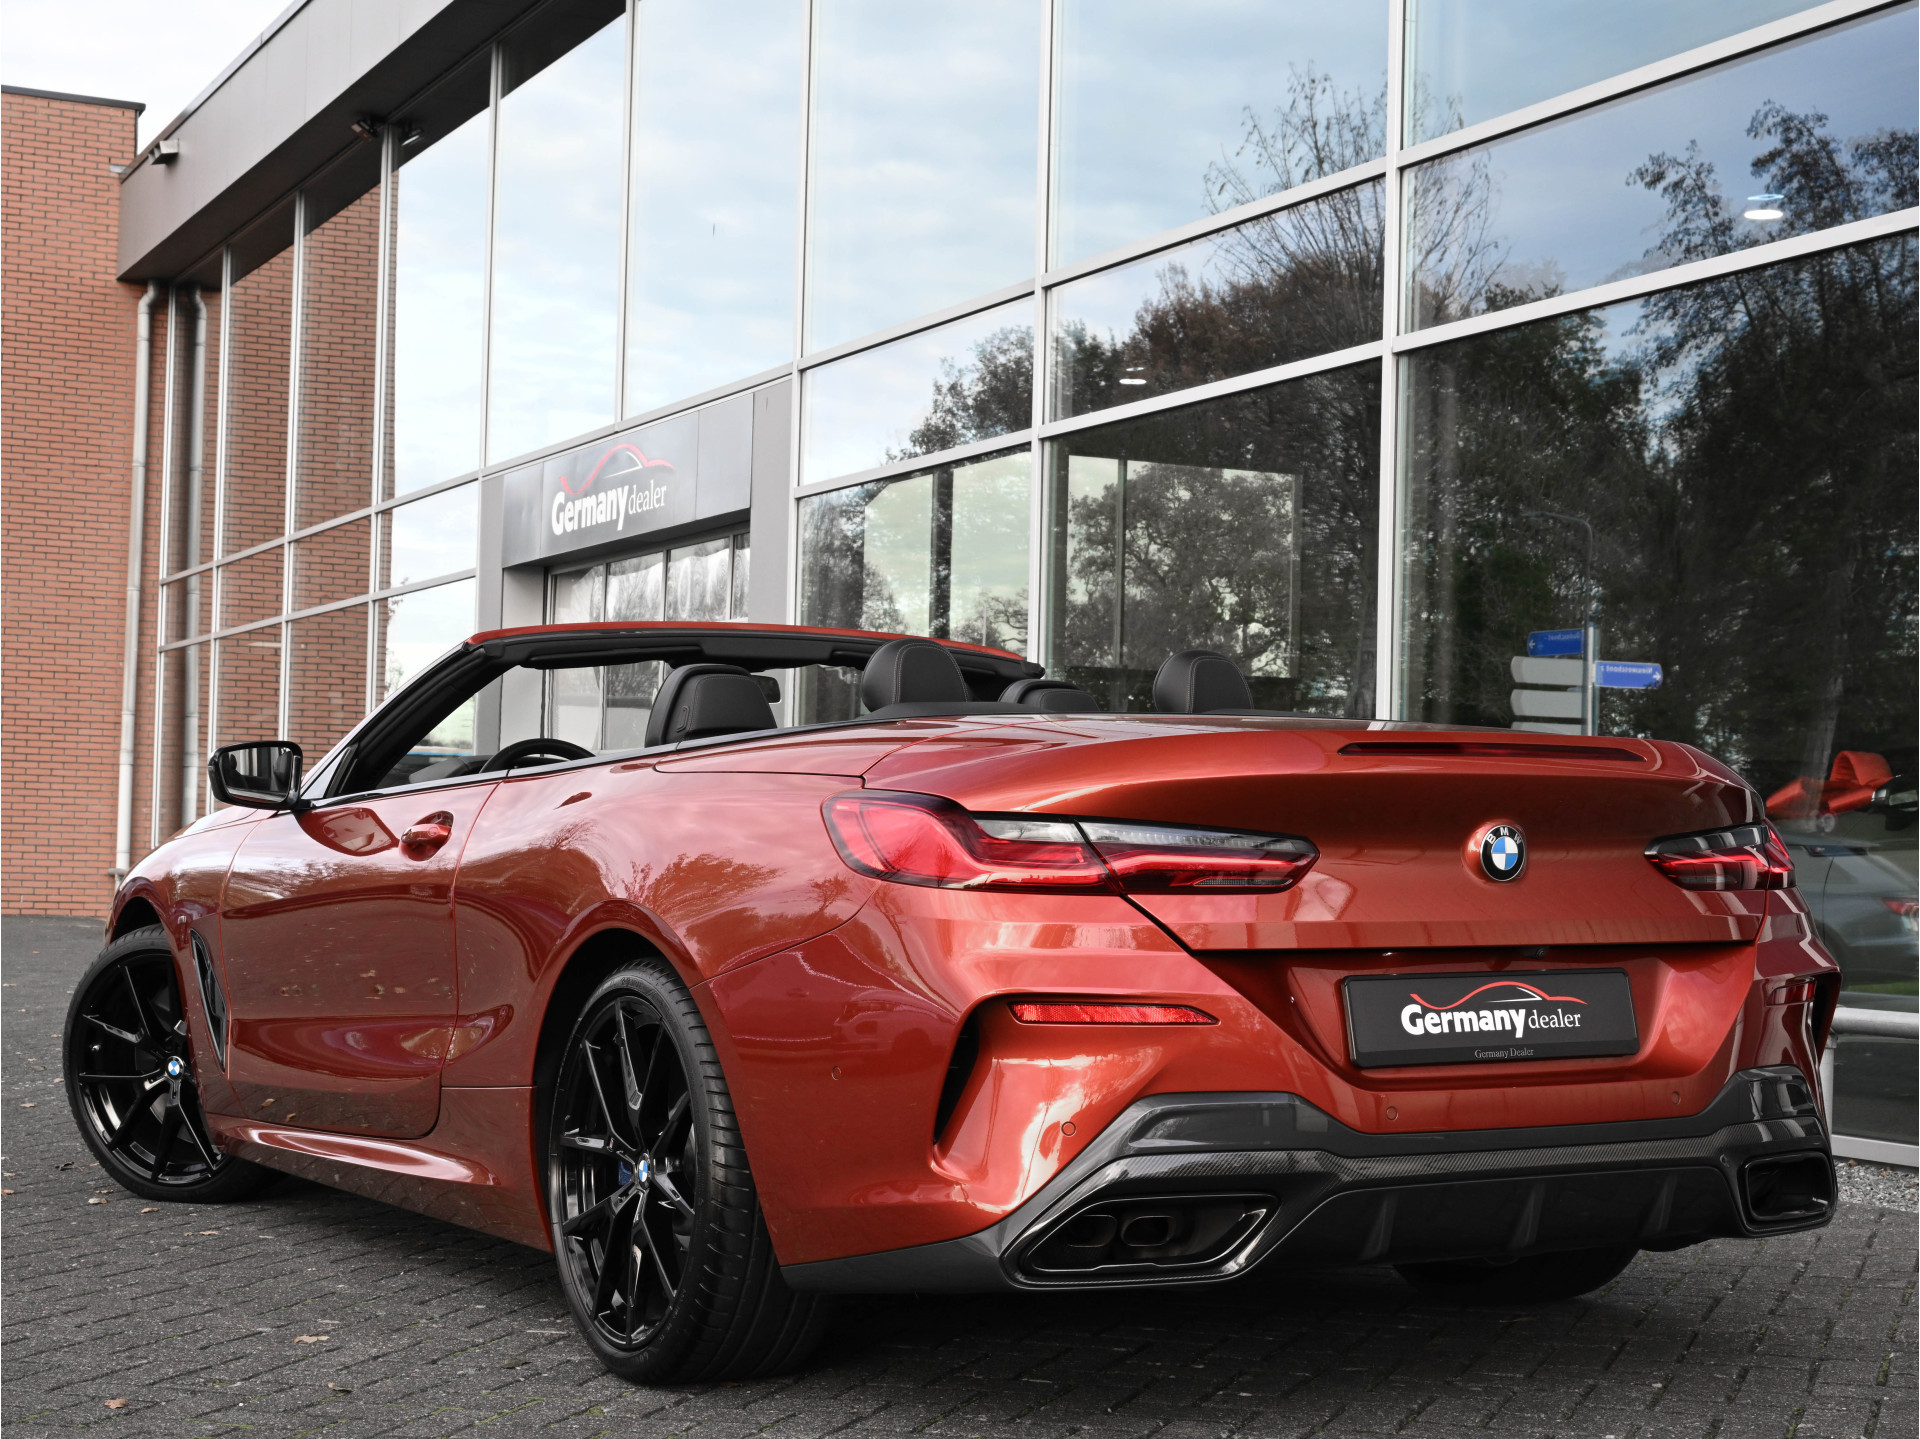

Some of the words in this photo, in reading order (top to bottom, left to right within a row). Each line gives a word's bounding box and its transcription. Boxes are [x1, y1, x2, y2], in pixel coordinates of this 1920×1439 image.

[552, 485, 629, 536] Germany
[628, 480, 667, 515] dealer
[1486, 826, 1521, 845] BMW
[1401, 1003, 1526, 1038] Germany
[1528, 1008, 1581, 1029] dealer
[1474, 1049, 1509, 1060] Germany
[1510, 1047, 1534, 1057] Dealer
